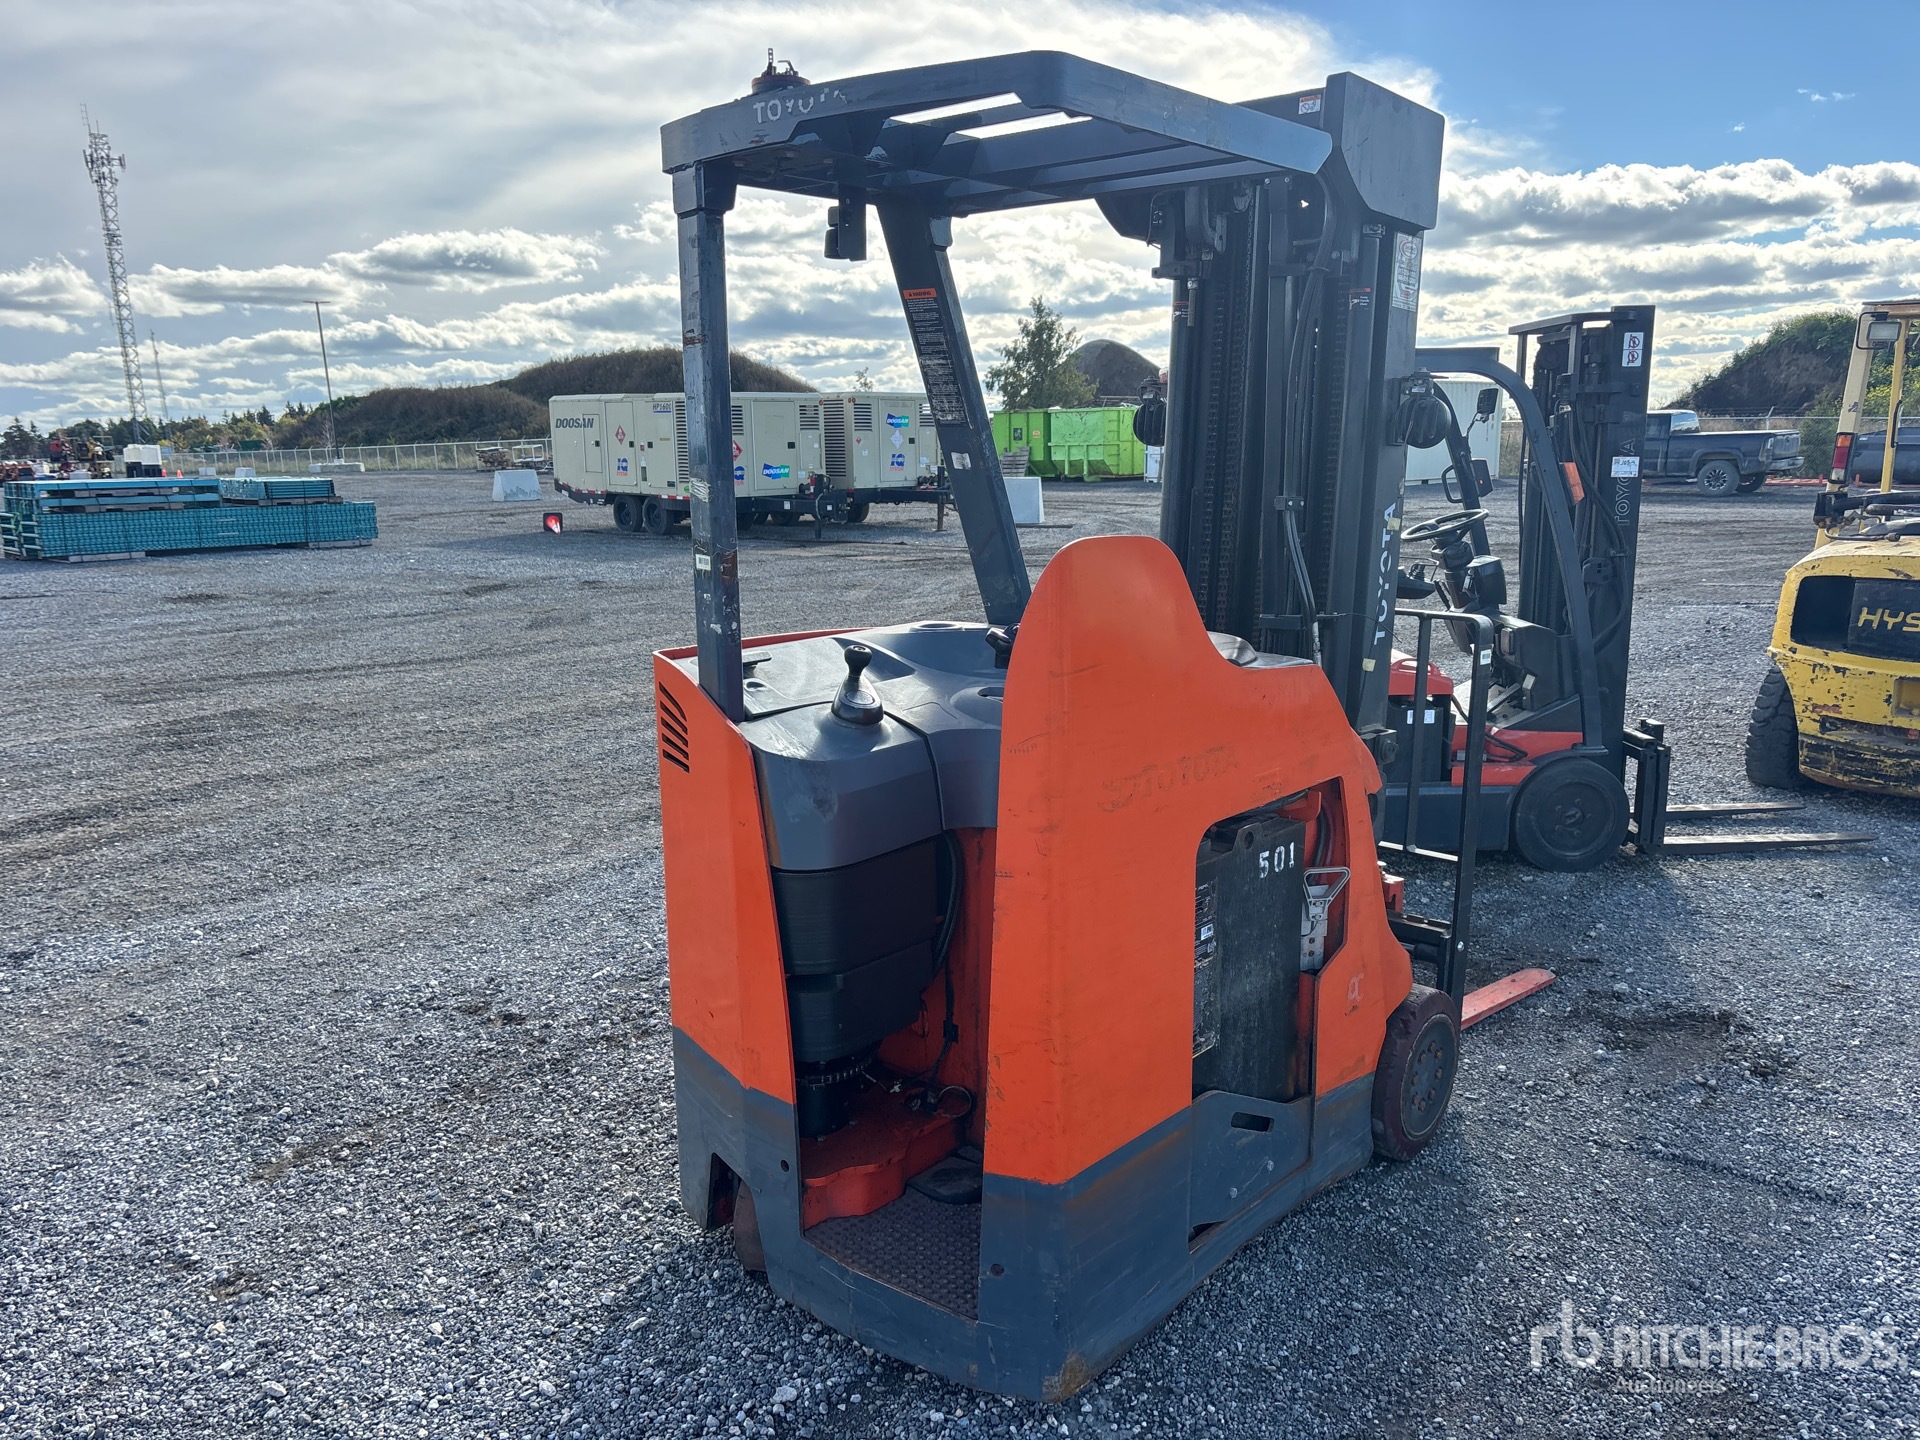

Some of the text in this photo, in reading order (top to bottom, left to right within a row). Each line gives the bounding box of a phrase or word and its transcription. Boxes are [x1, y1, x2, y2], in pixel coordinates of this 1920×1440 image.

[555, 417, 594, 429] DOOSAN
[762, 467, 790, 475] DOOSAN
[1614, 438, 1636, 526] TOYOA
[1258, 841, 1297, 879] 501
